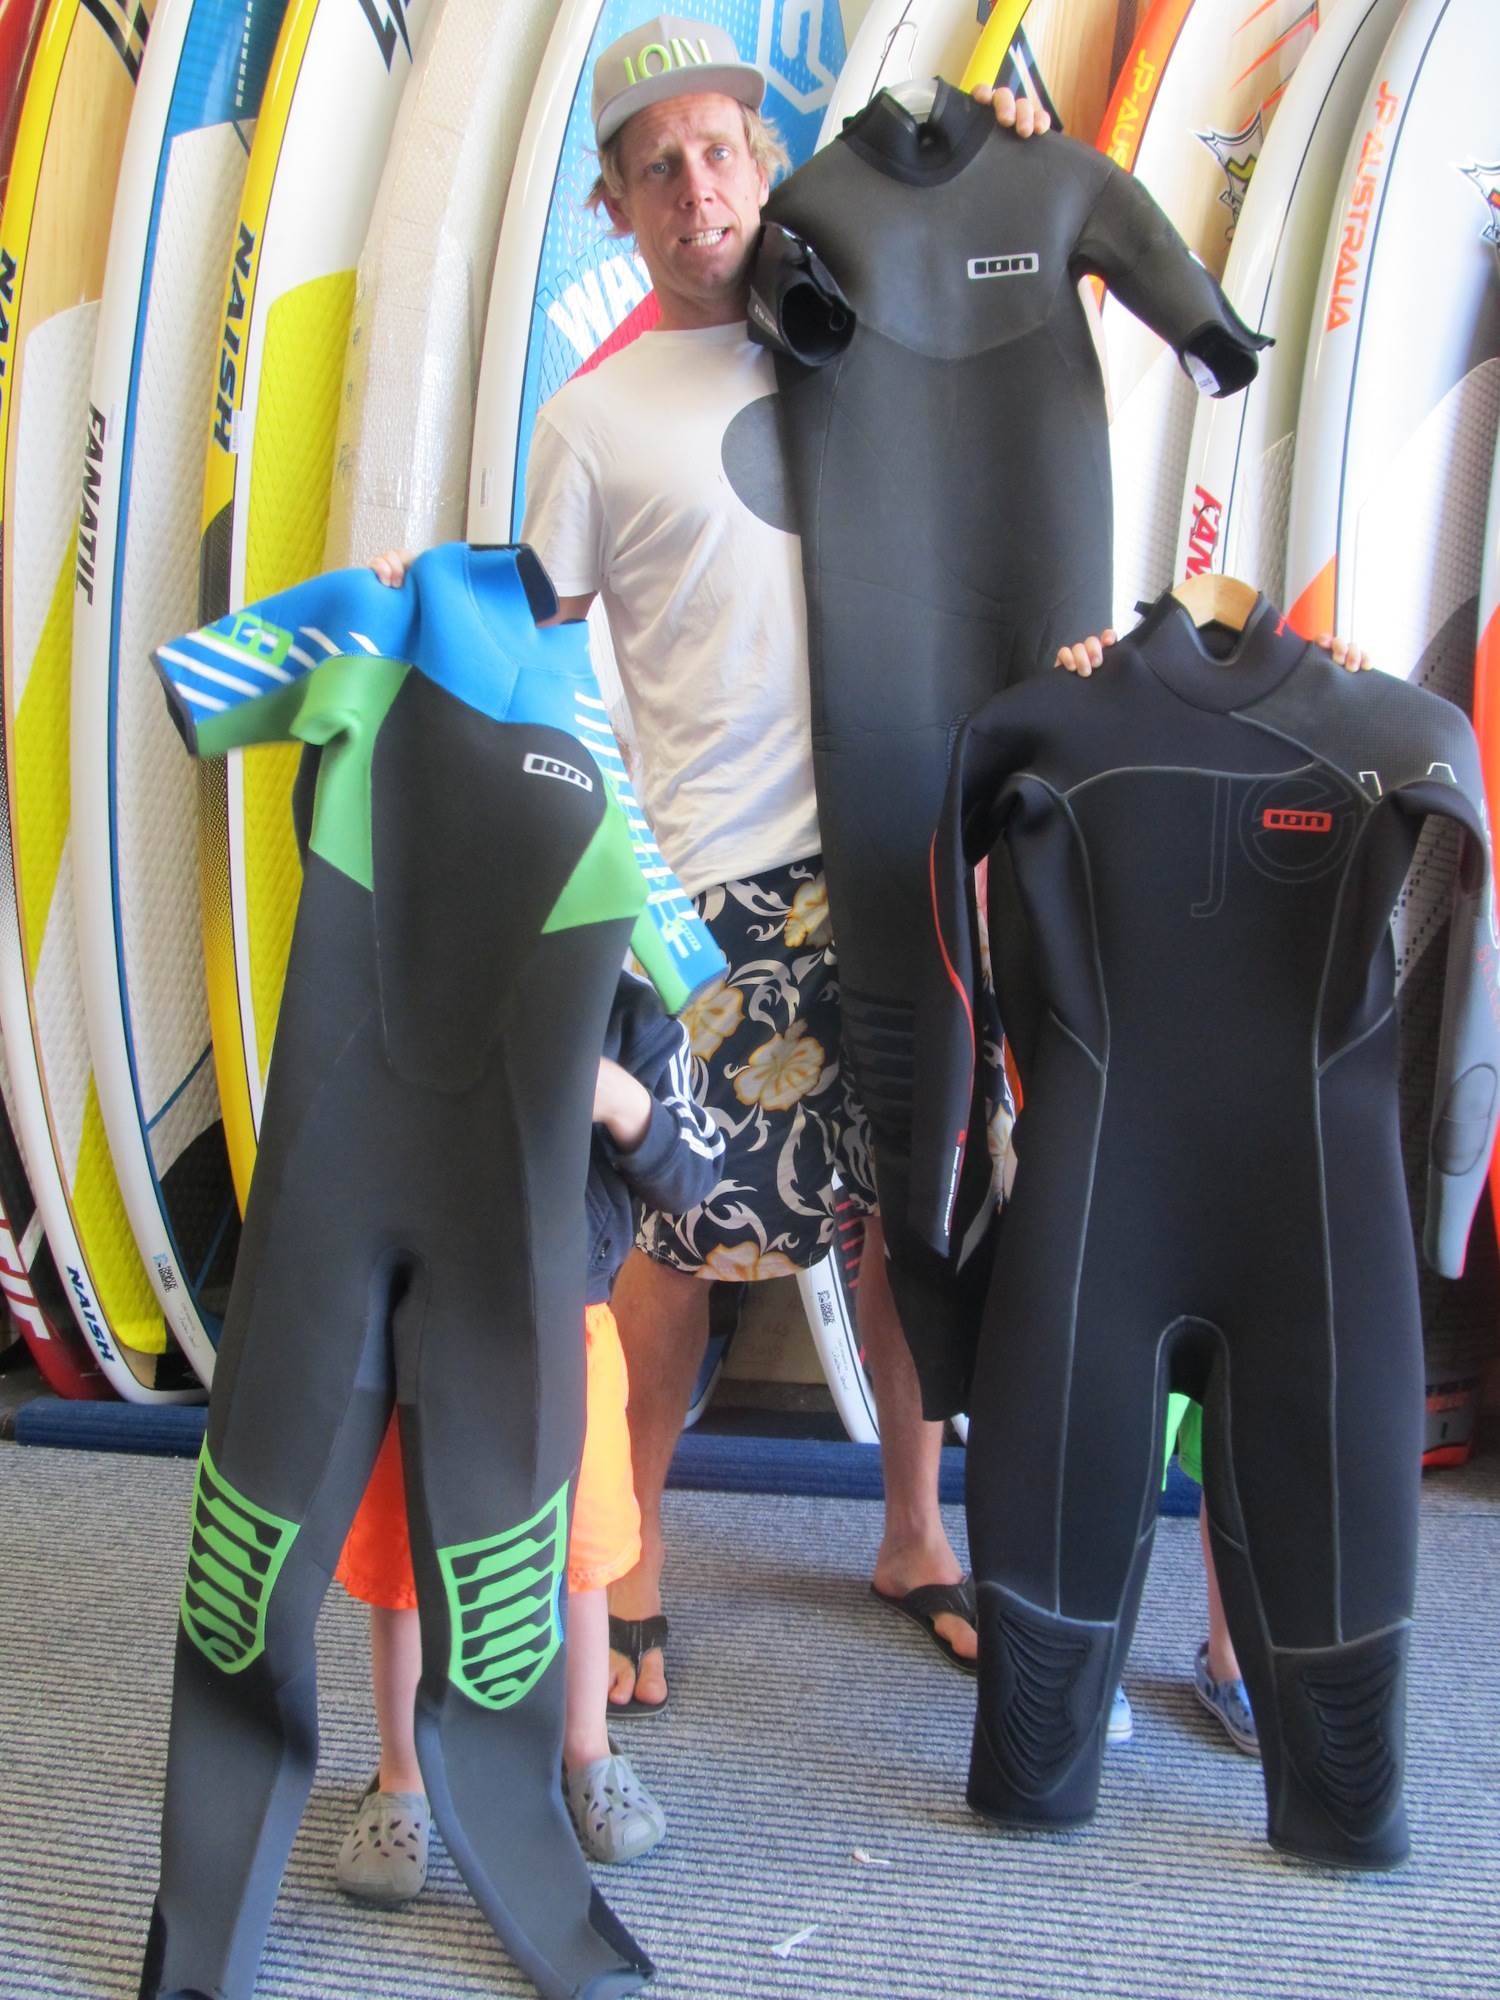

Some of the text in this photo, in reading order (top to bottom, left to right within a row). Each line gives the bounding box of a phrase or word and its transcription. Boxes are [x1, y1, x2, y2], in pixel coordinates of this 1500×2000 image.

[623, 38, 713, 86] ION
[1106, 49, 1156, 169] JP-AUS
[1325, 80, 1399, 333] JP-AUSTRALIA
[213, 221, 257, 453] NAISH
[75, 400, 107, 606] FANATIC
[1185, 485, 1222, 580] FAN
[66, 1265, 116, 1362] NAISH
